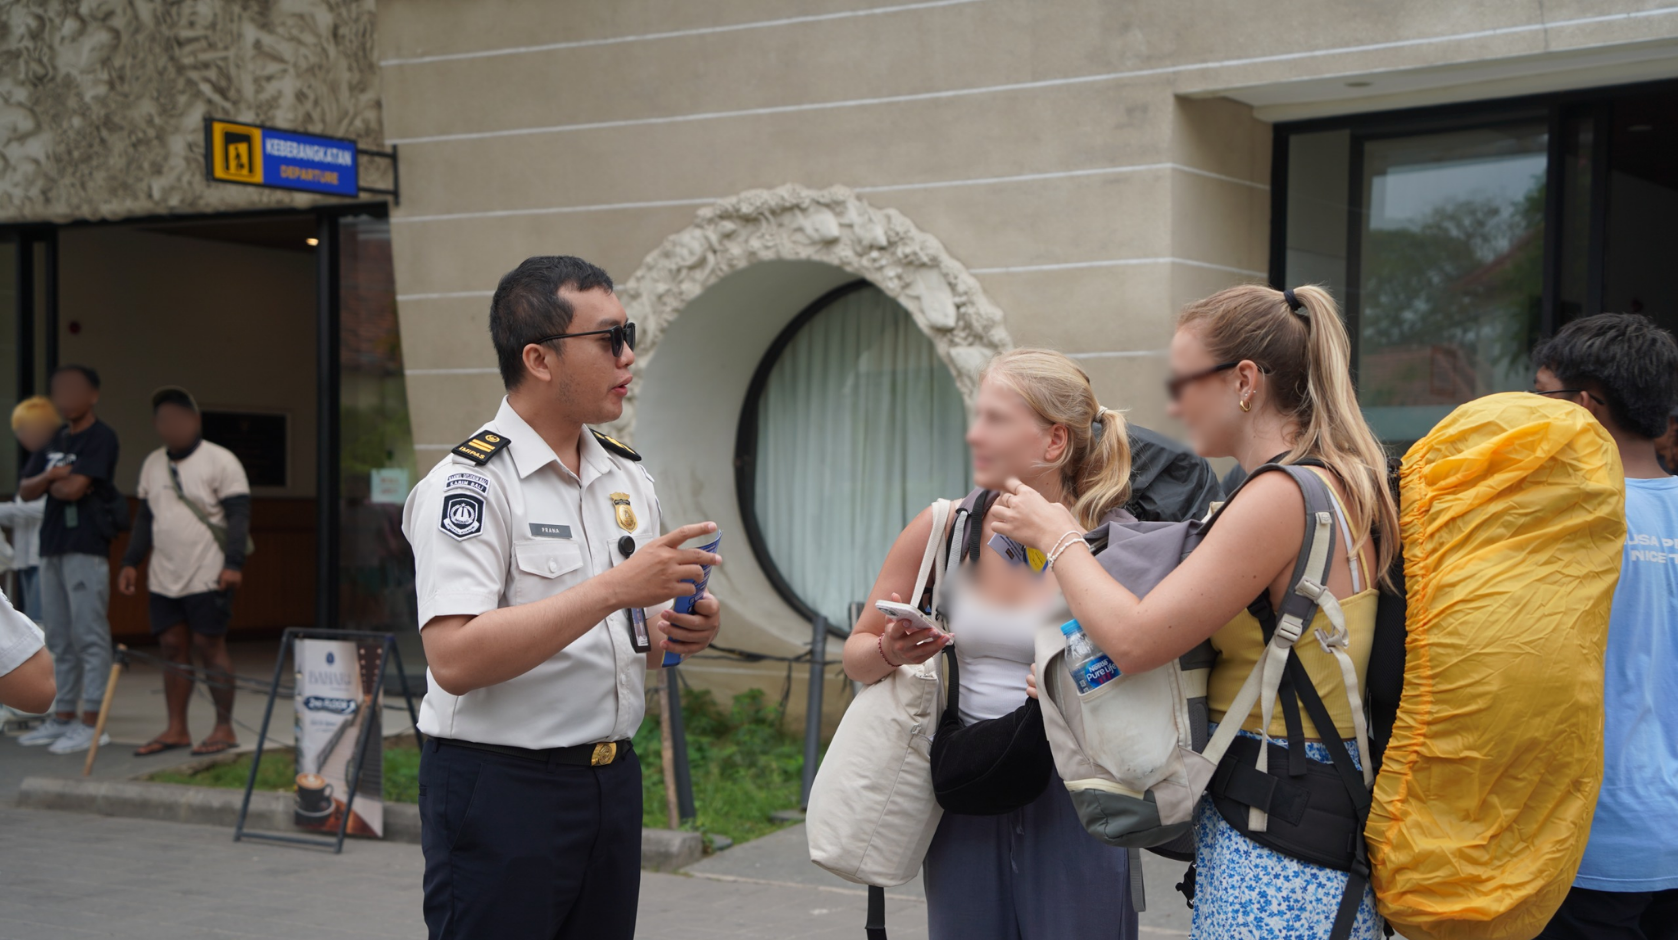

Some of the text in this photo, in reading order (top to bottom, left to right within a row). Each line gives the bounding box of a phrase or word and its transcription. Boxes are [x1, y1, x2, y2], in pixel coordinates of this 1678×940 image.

[265, 138, 352, 167] KEBERANGKATAN
[280, 165, 339, 185] DEPARTURE
[458, 446, 486, 460] IMIPAS
[1624, 534, 1659, 546] USA
[1631, 550, 1667, 563] NICE
[1086, 664, 1116, 682] Pure Life
